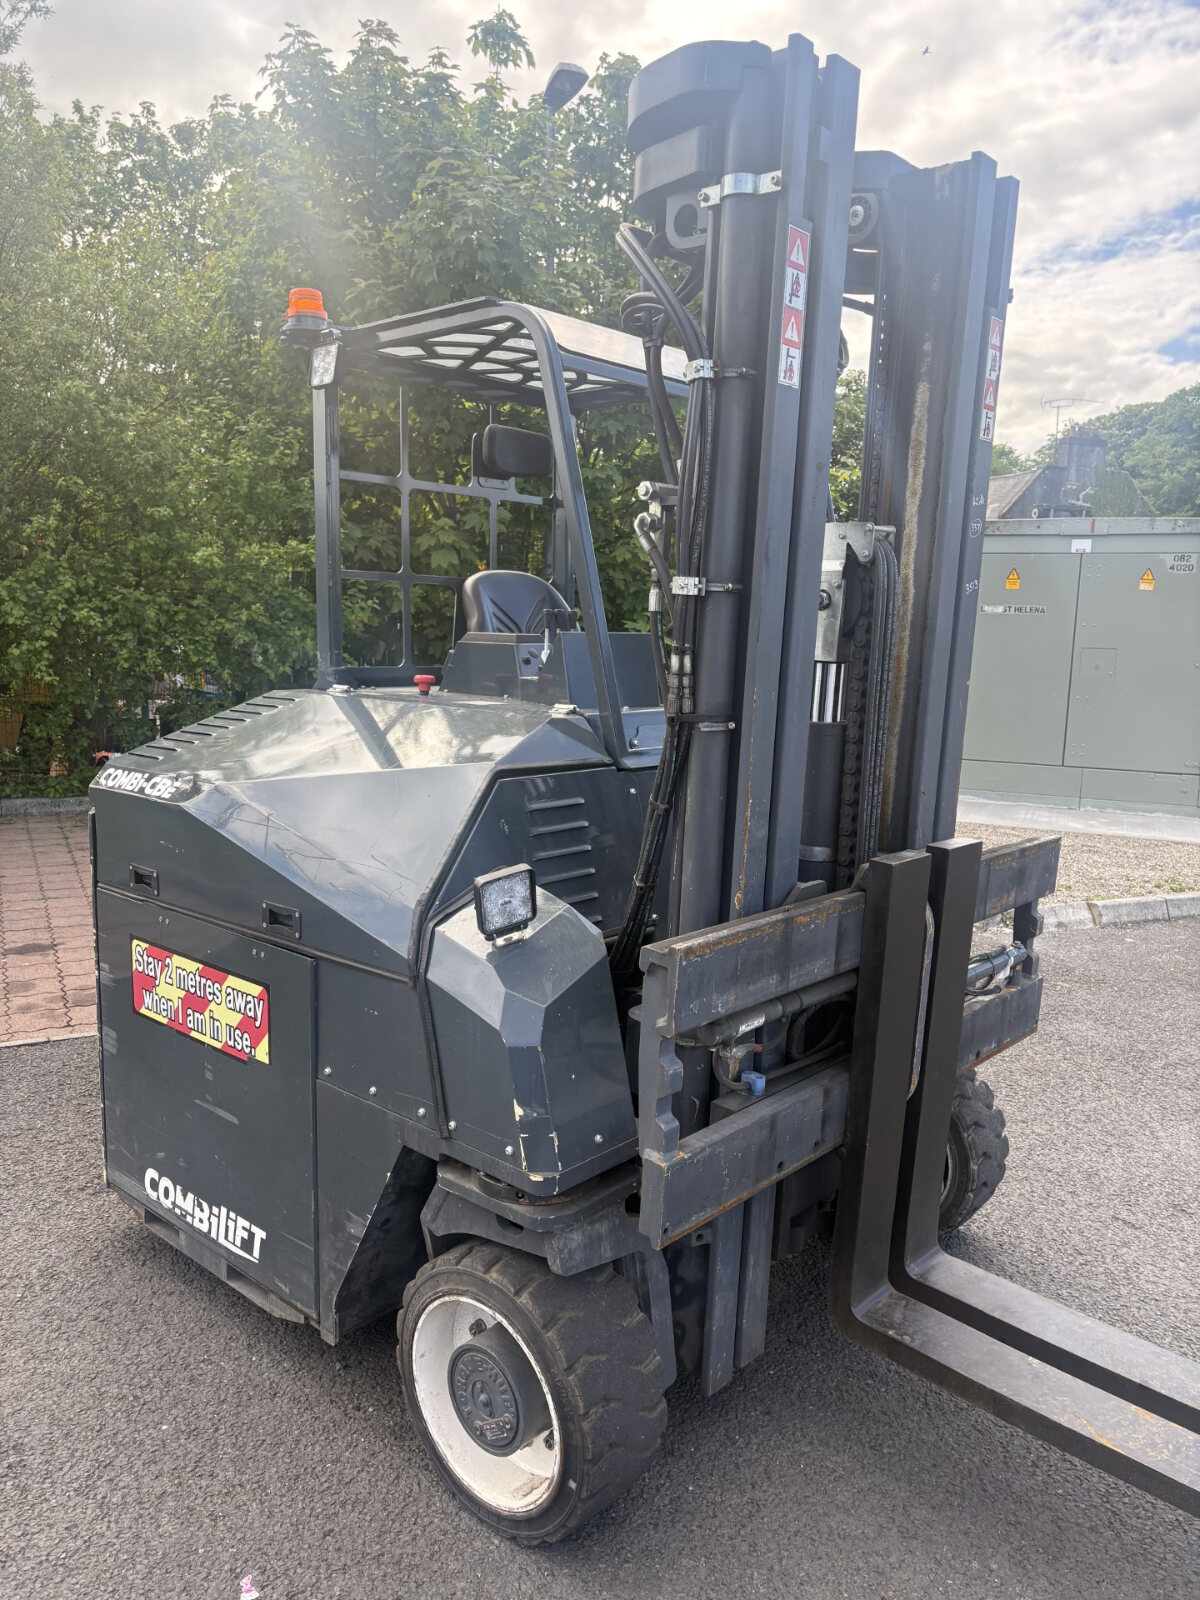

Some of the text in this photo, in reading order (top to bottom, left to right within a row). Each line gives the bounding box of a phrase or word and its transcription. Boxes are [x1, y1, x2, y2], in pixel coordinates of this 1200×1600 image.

[1169, 564, 1194, 572] 4020
[1014, 605, 1046, 614] HELENA
[135, 944, 264, 1028] Stay 2 metres away
[142, 986, 256, 1057] when I am in use.
